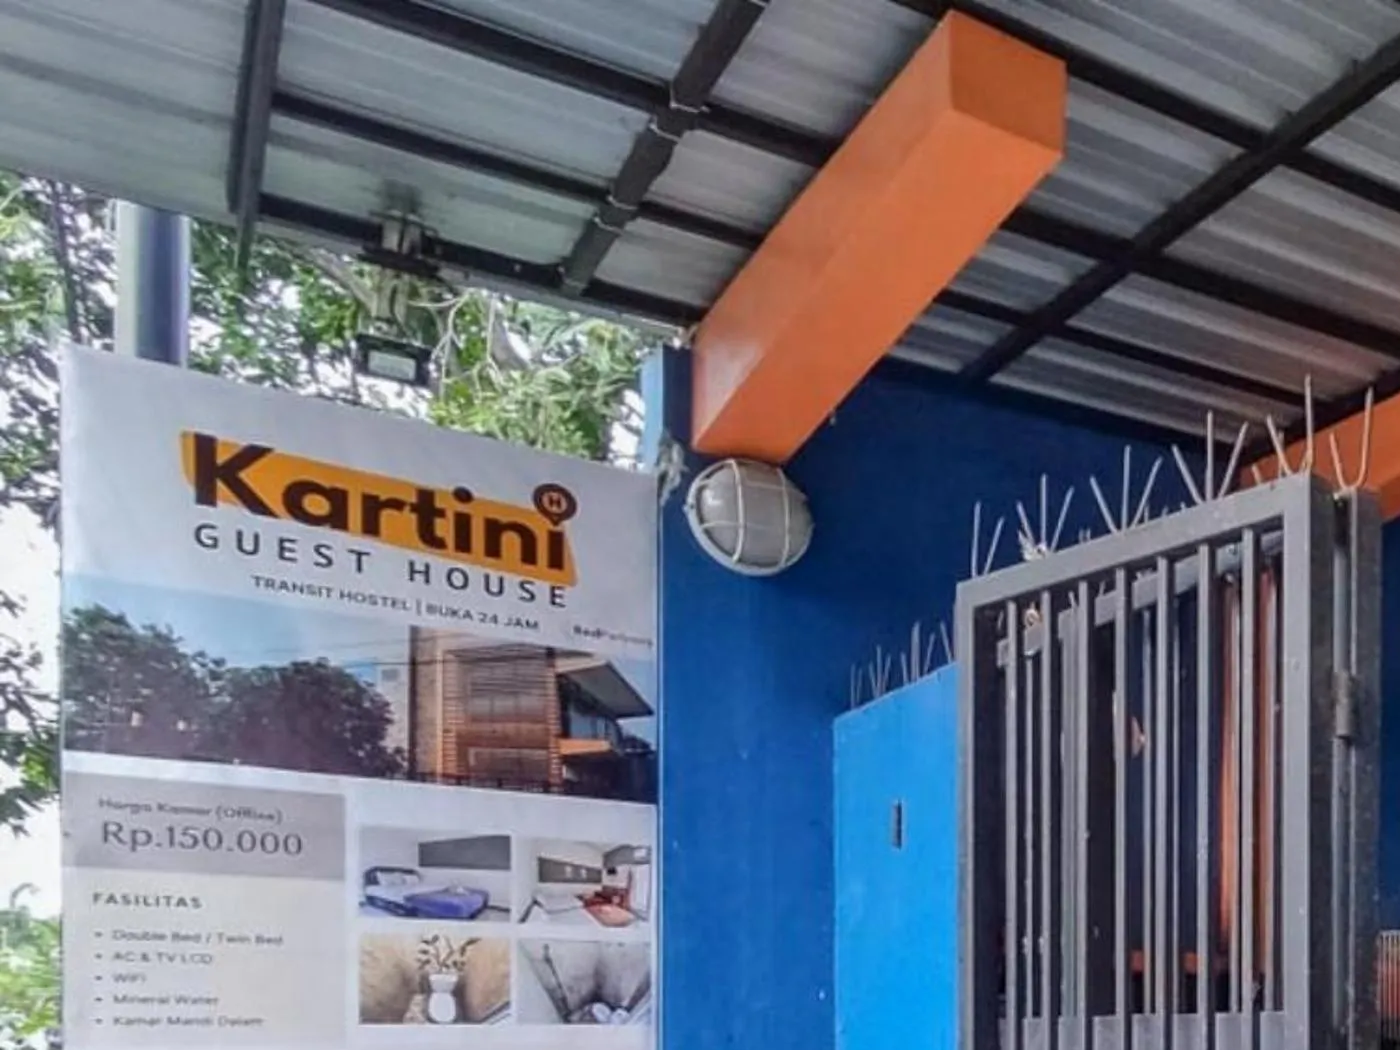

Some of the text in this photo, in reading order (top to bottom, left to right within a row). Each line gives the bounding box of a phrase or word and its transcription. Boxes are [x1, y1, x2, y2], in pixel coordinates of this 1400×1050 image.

[192, 431, 577, 571] Kartini
[195, 522, 568, 608] GUEST HOUSE
[251, 575, 332, 599] TRANSIT
[340, 589, 411, 612] HOSTEL
[426, 601, 474, 622] BUKA
[478, 611, 498, 625] 24
[504, 614, 539, 631] JAM
[102, 820, 303, 856] Rp.150.000
[92, 893, 202, 909] FASILITAS
[112, 929, 168, 942] Double
[112, 951, 136, 962] AC
[157, 952, 177, 963] TV
